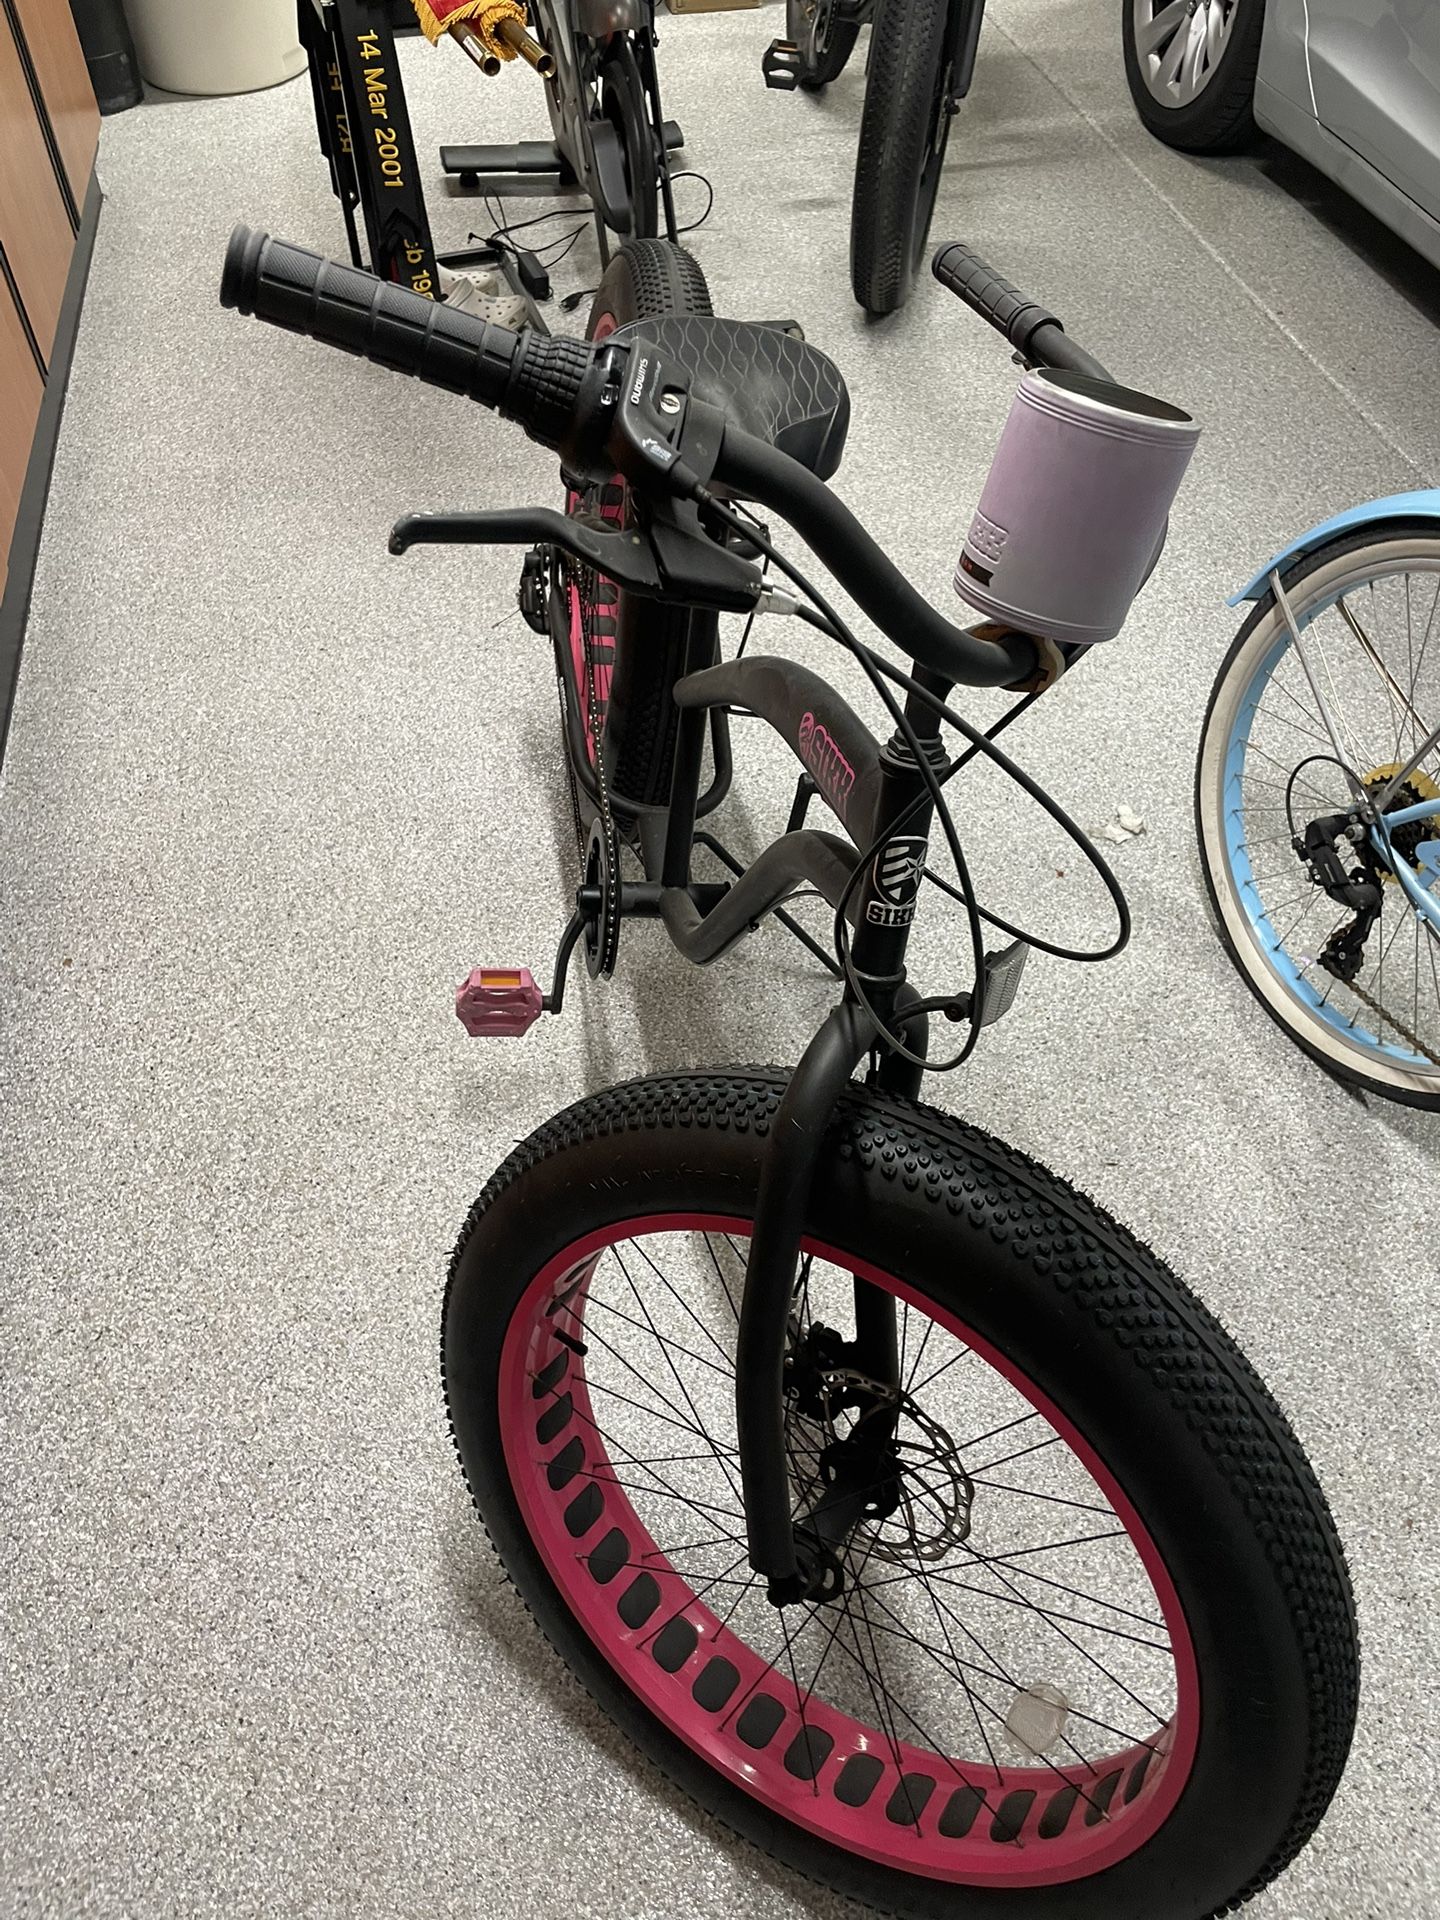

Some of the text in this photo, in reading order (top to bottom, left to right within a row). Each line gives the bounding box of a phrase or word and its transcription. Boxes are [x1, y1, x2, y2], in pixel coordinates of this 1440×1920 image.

[357, 29, 404, 187] 14 Mar 2001
[630, 358, 648, 405] SHIMANO
